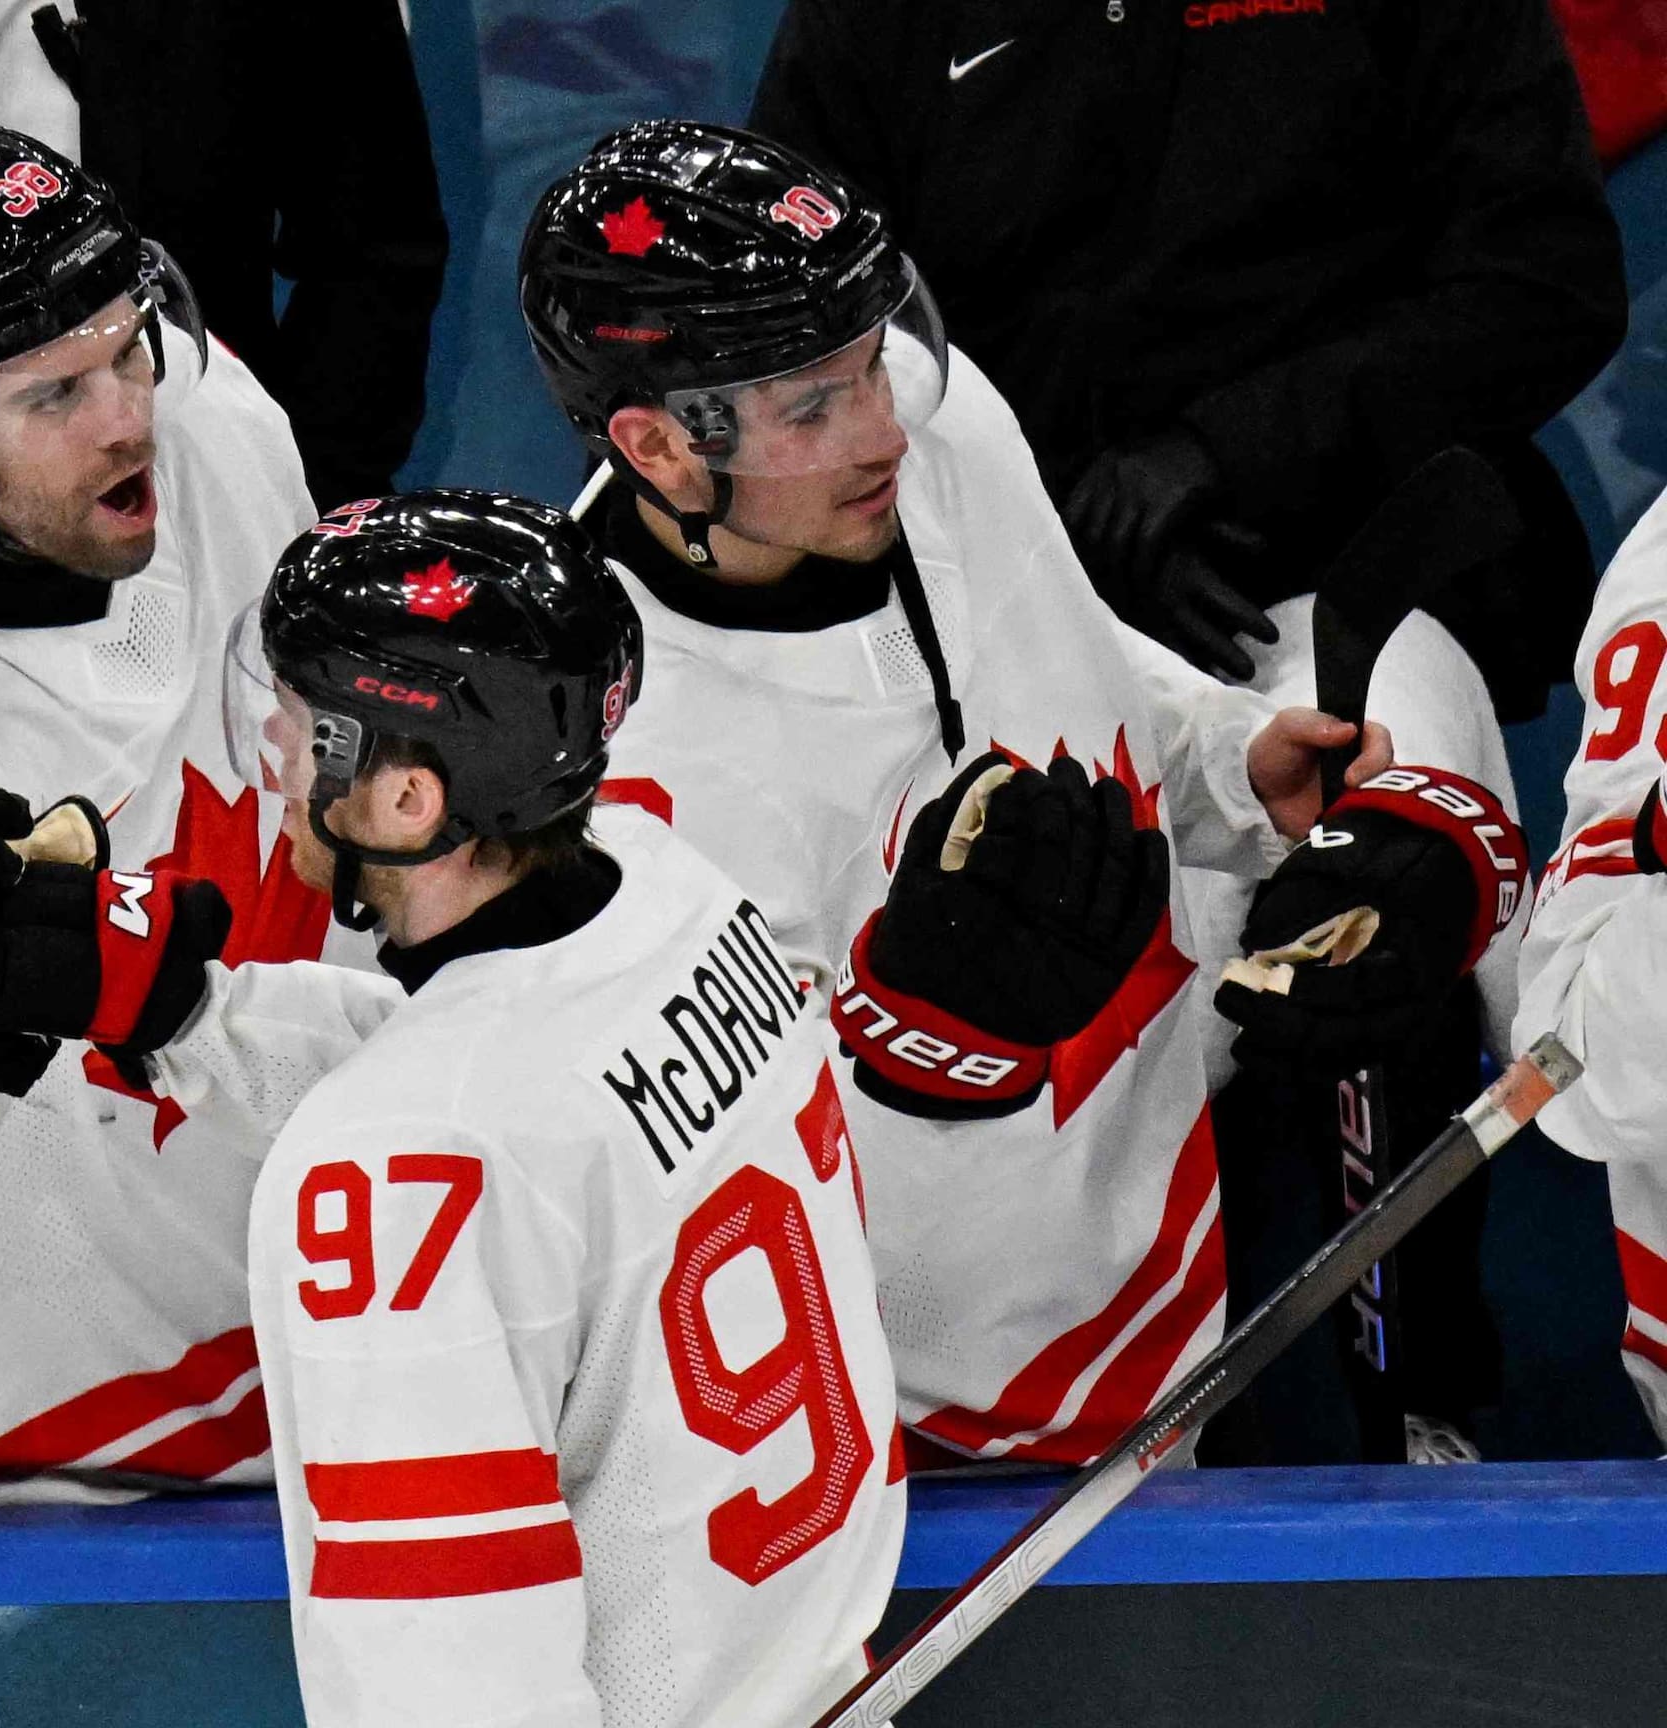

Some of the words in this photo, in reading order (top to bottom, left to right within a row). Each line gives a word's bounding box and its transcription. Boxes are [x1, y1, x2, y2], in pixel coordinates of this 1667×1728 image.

[769, 186, 841, 241] 10
[354, 676, 439, 710] CCM
[602, 898, 807, 1174] McDAVID
[296, 1153, 484, 1322] 97
